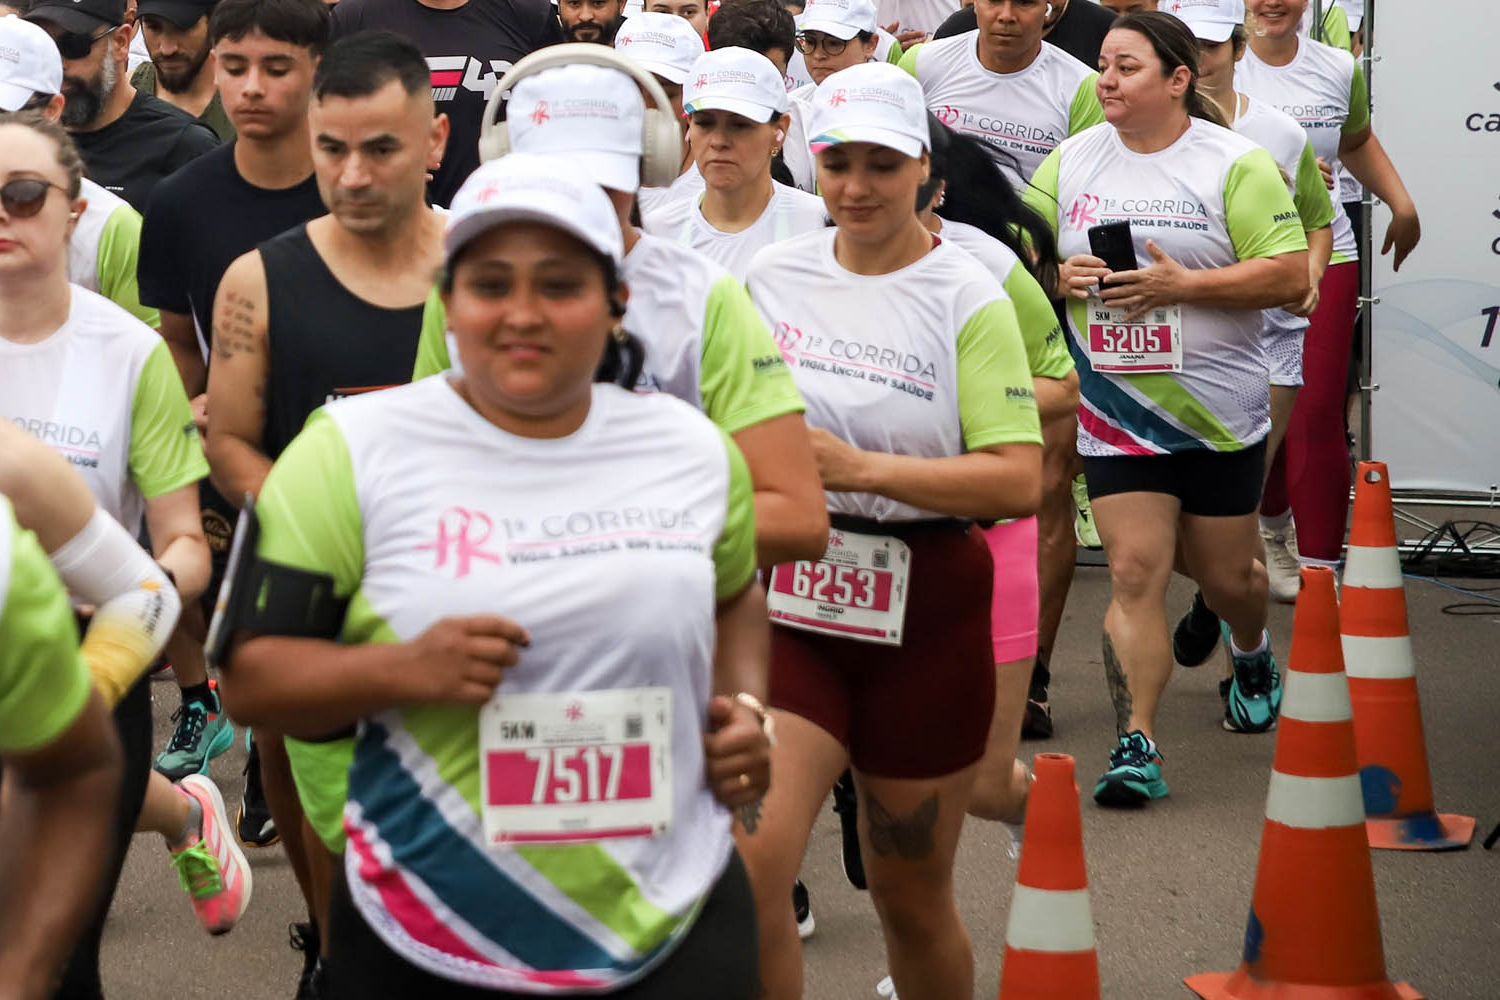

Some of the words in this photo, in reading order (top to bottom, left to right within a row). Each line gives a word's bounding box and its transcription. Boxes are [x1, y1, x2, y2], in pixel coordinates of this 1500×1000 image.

[978, 116, 1056, 144] CORRIDA
[1009, 141, 1023, 151] EM
[1122, 199, 1208, 218] CORRIDA
[1157, 219, 1172, 228] EM
[1174, 219, 1209, 231] SAÚDE
[1095, 311, 1110, 321] 5KM
[1102, 326, 1161, 352] 5205
[829, 338, 937, 382] CORRIDA
[799, 358, 866, 381] VIGILÂNCIA
[868, 373, 888, 386] EM
[890, 378, 935, 402] SAÚDE
[540, 507, 699, 539] CORRIDA
[792, 560, 876, 608] 6253
[525, 746, 623, 804] 7517
